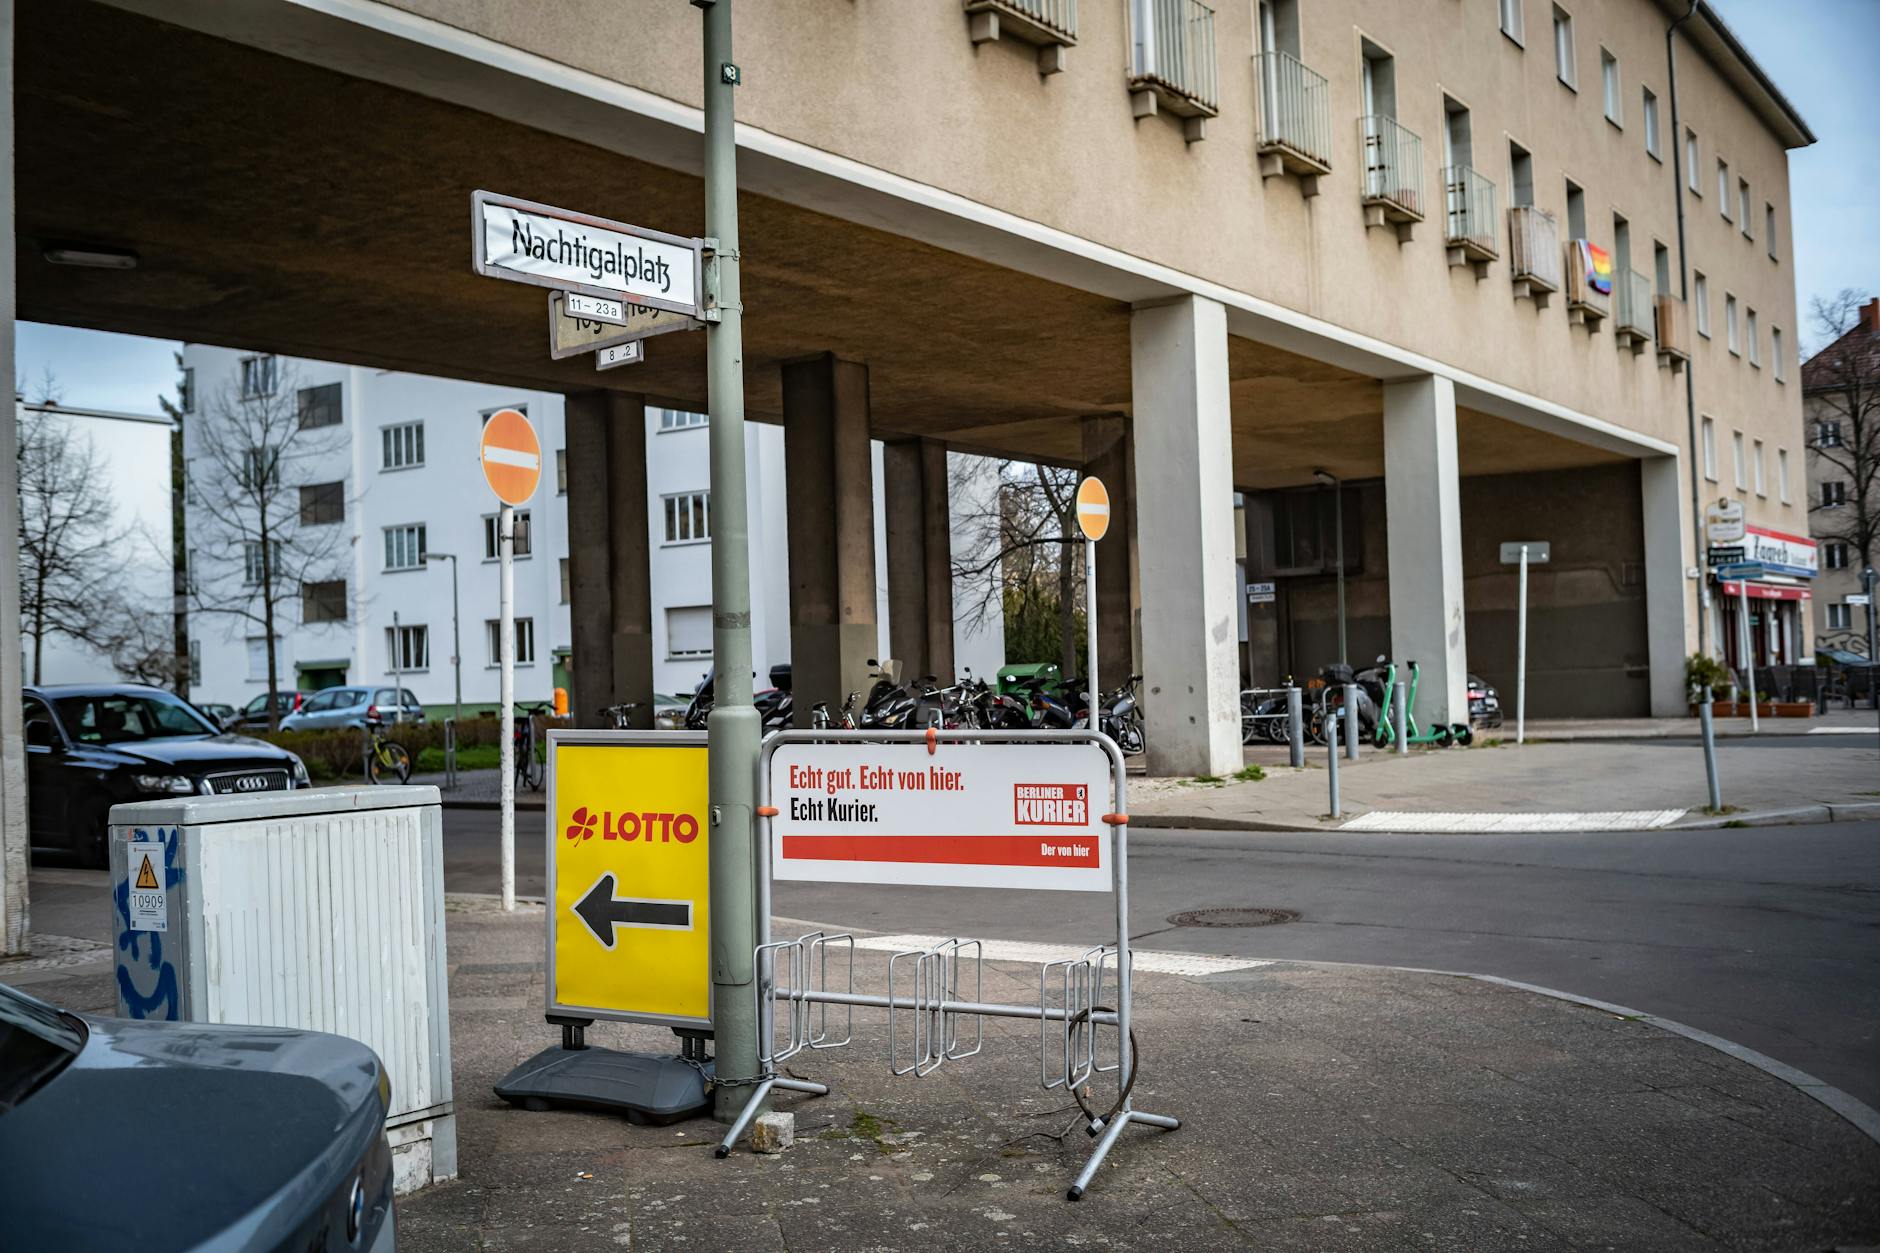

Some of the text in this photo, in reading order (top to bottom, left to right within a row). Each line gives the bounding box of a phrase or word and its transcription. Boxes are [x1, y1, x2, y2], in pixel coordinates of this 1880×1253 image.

[789, 764, 964, 795] Echt gut. Echt von hier.
[1016, 786, 1064, 800] BERLINER
[790, 797, 878, 823] Echt Kurier.
[1016, 799, 1087, 824] KURIER
[603, 811, 699, 844] LOTTO
[1041, 843, 1090, 857] Der von hier
[132, 894, 164, 909] 10909
